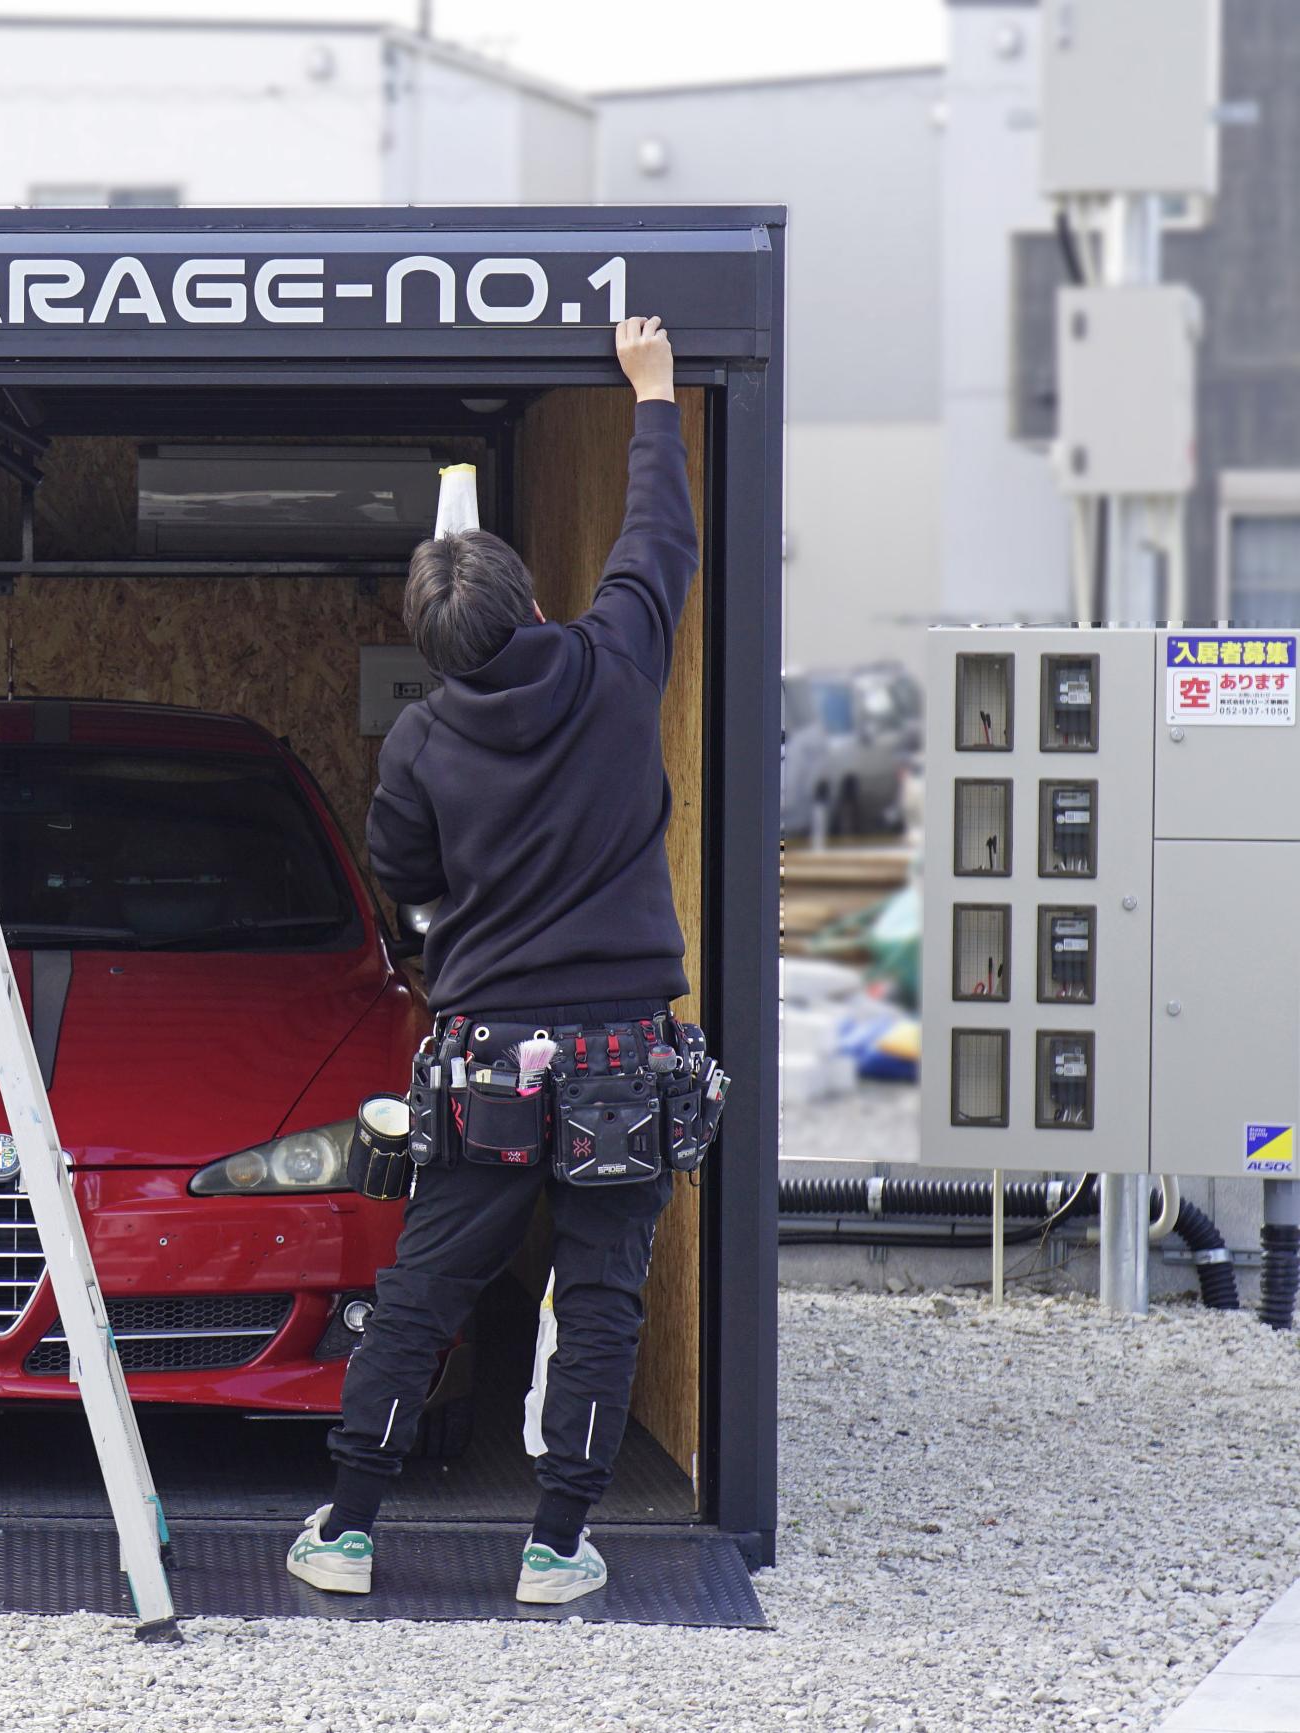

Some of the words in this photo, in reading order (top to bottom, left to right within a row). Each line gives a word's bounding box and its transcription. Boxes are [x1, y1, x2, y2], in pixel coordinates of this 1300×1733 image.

[1174, 641, 1289, 664] 入居者募集
[1180, 677, 1210, 708] 空
[1220, 673, 1289, 690] あります
[1219, 706, 1289, 715] 052-937-1050
[1247, 1161, 1292, 1172] ALSOK
